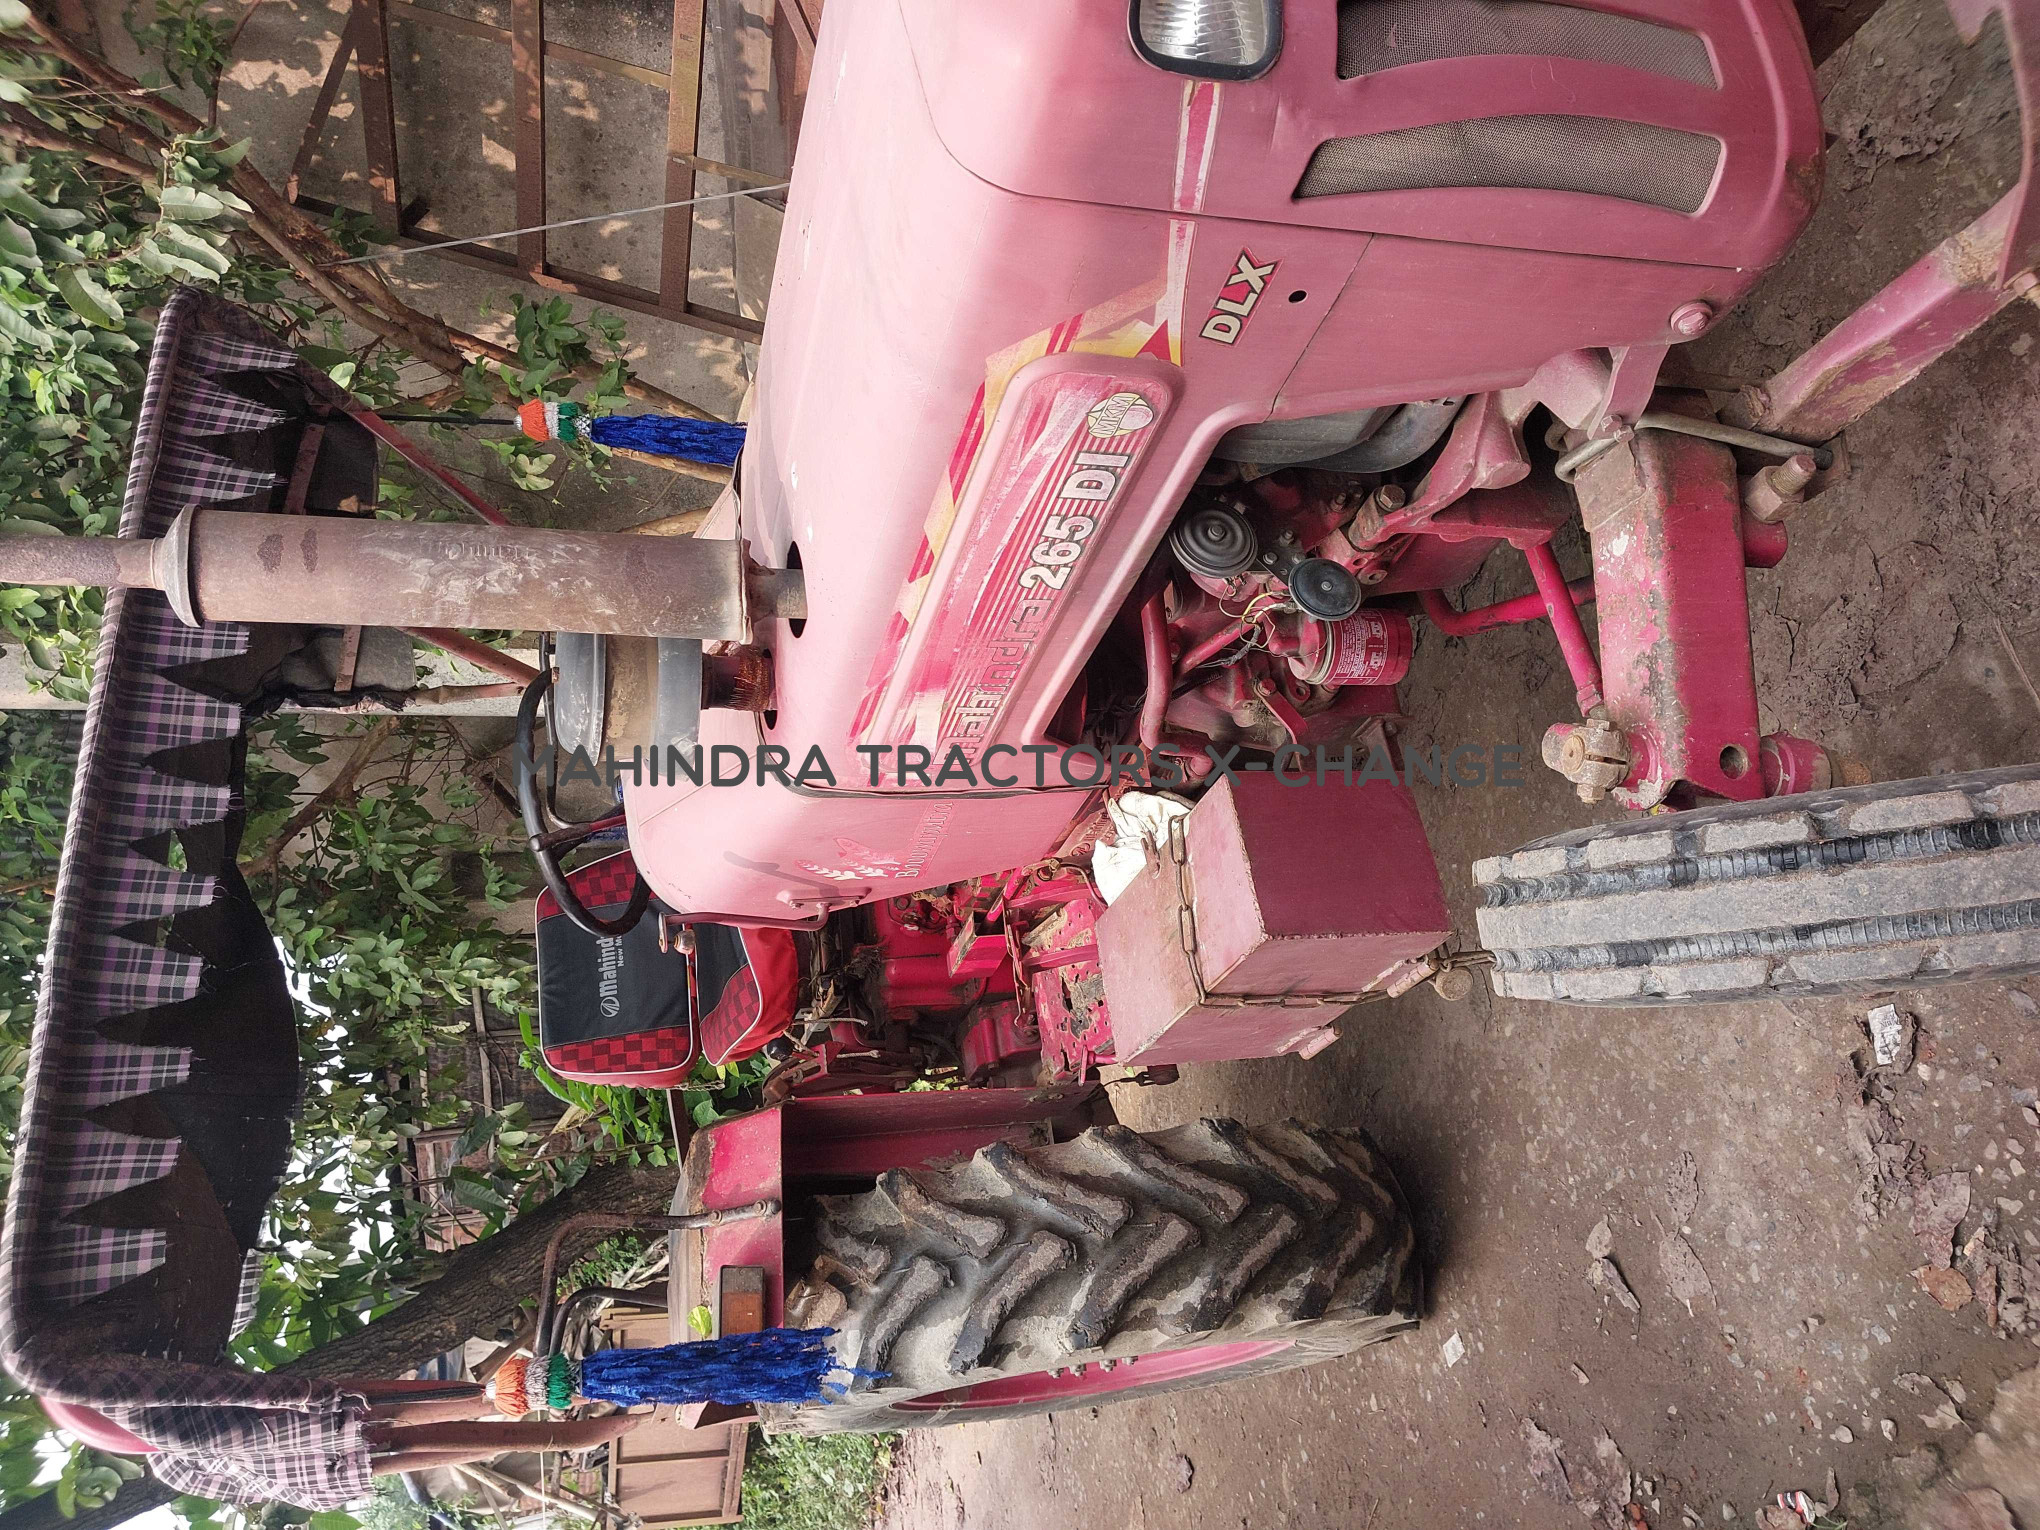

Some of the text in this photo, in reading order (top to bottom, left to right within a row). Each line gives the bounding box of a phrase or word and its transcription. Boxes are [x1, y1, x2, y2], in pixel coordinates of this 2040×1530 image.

[1199, 251, 1277, 345] DLX
[1090, 395, 1136, 435] MKM
[1017, 515, 1095, 591] 265
[1057, 451, 1131, 501] DI
[596, 936, 617, 997] Mahind
[616, 948, 624, 967] New
